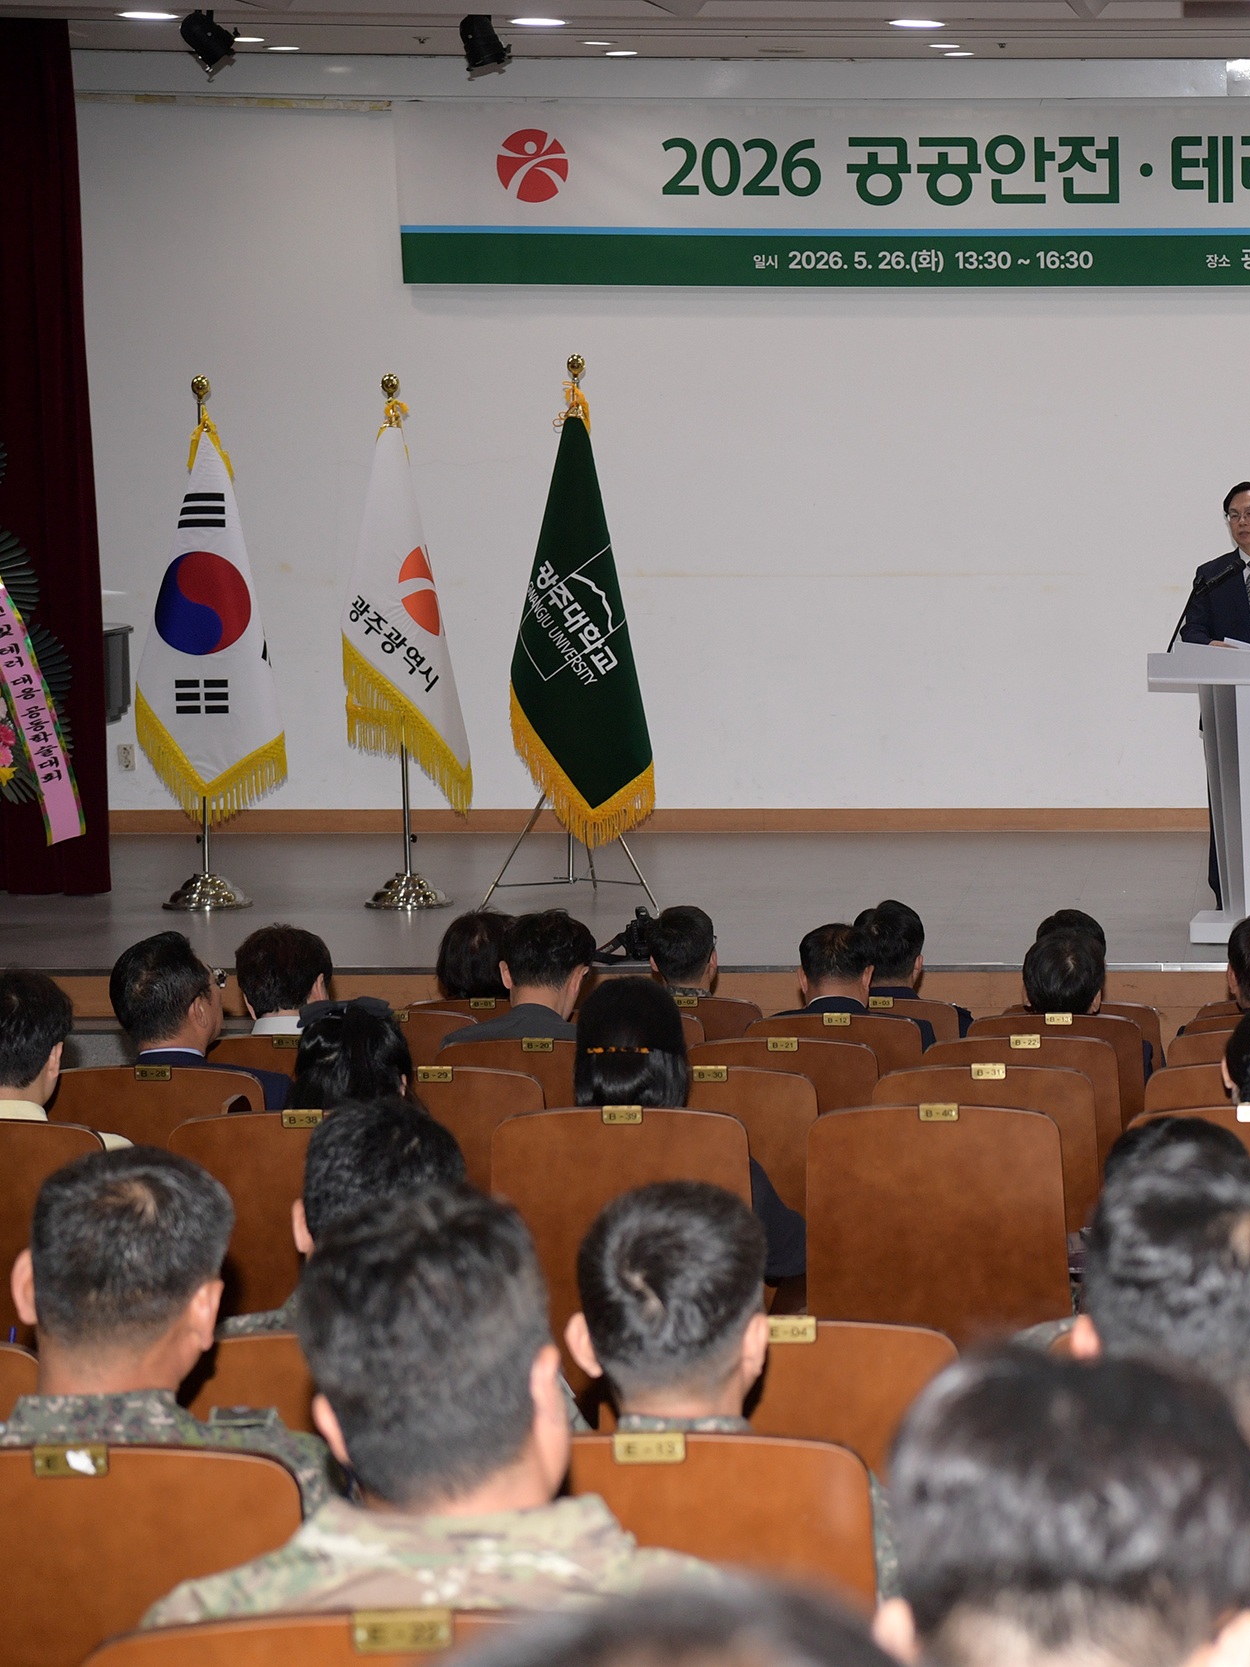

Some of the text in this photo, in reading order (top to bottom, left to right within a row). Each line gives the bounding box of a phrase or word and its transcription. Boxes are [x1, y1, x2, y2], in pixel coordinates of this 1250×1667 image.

[661, 137, 822, 197] 2026
[753, 254, 778, 269] 일시
[788, 250, 848, 270] 2026.
[853, 251, 873, 270] 5.
[878, 249, 944, 273] 26.(화)
[954, 251, 1012, 270] 13:30
[1036, 250, 1094, 269] 16:30
[1205, 253, 1231, 269] 장소
[527, 580, 598, 686] GWANGJU UNIVERSITY
[536, 560, 618, 675] 광주대학교
[0, 643, 24, 668] 테러
[349, 595, 440, 693] 광주광역시
[11, 674, 41, 700] 대응
